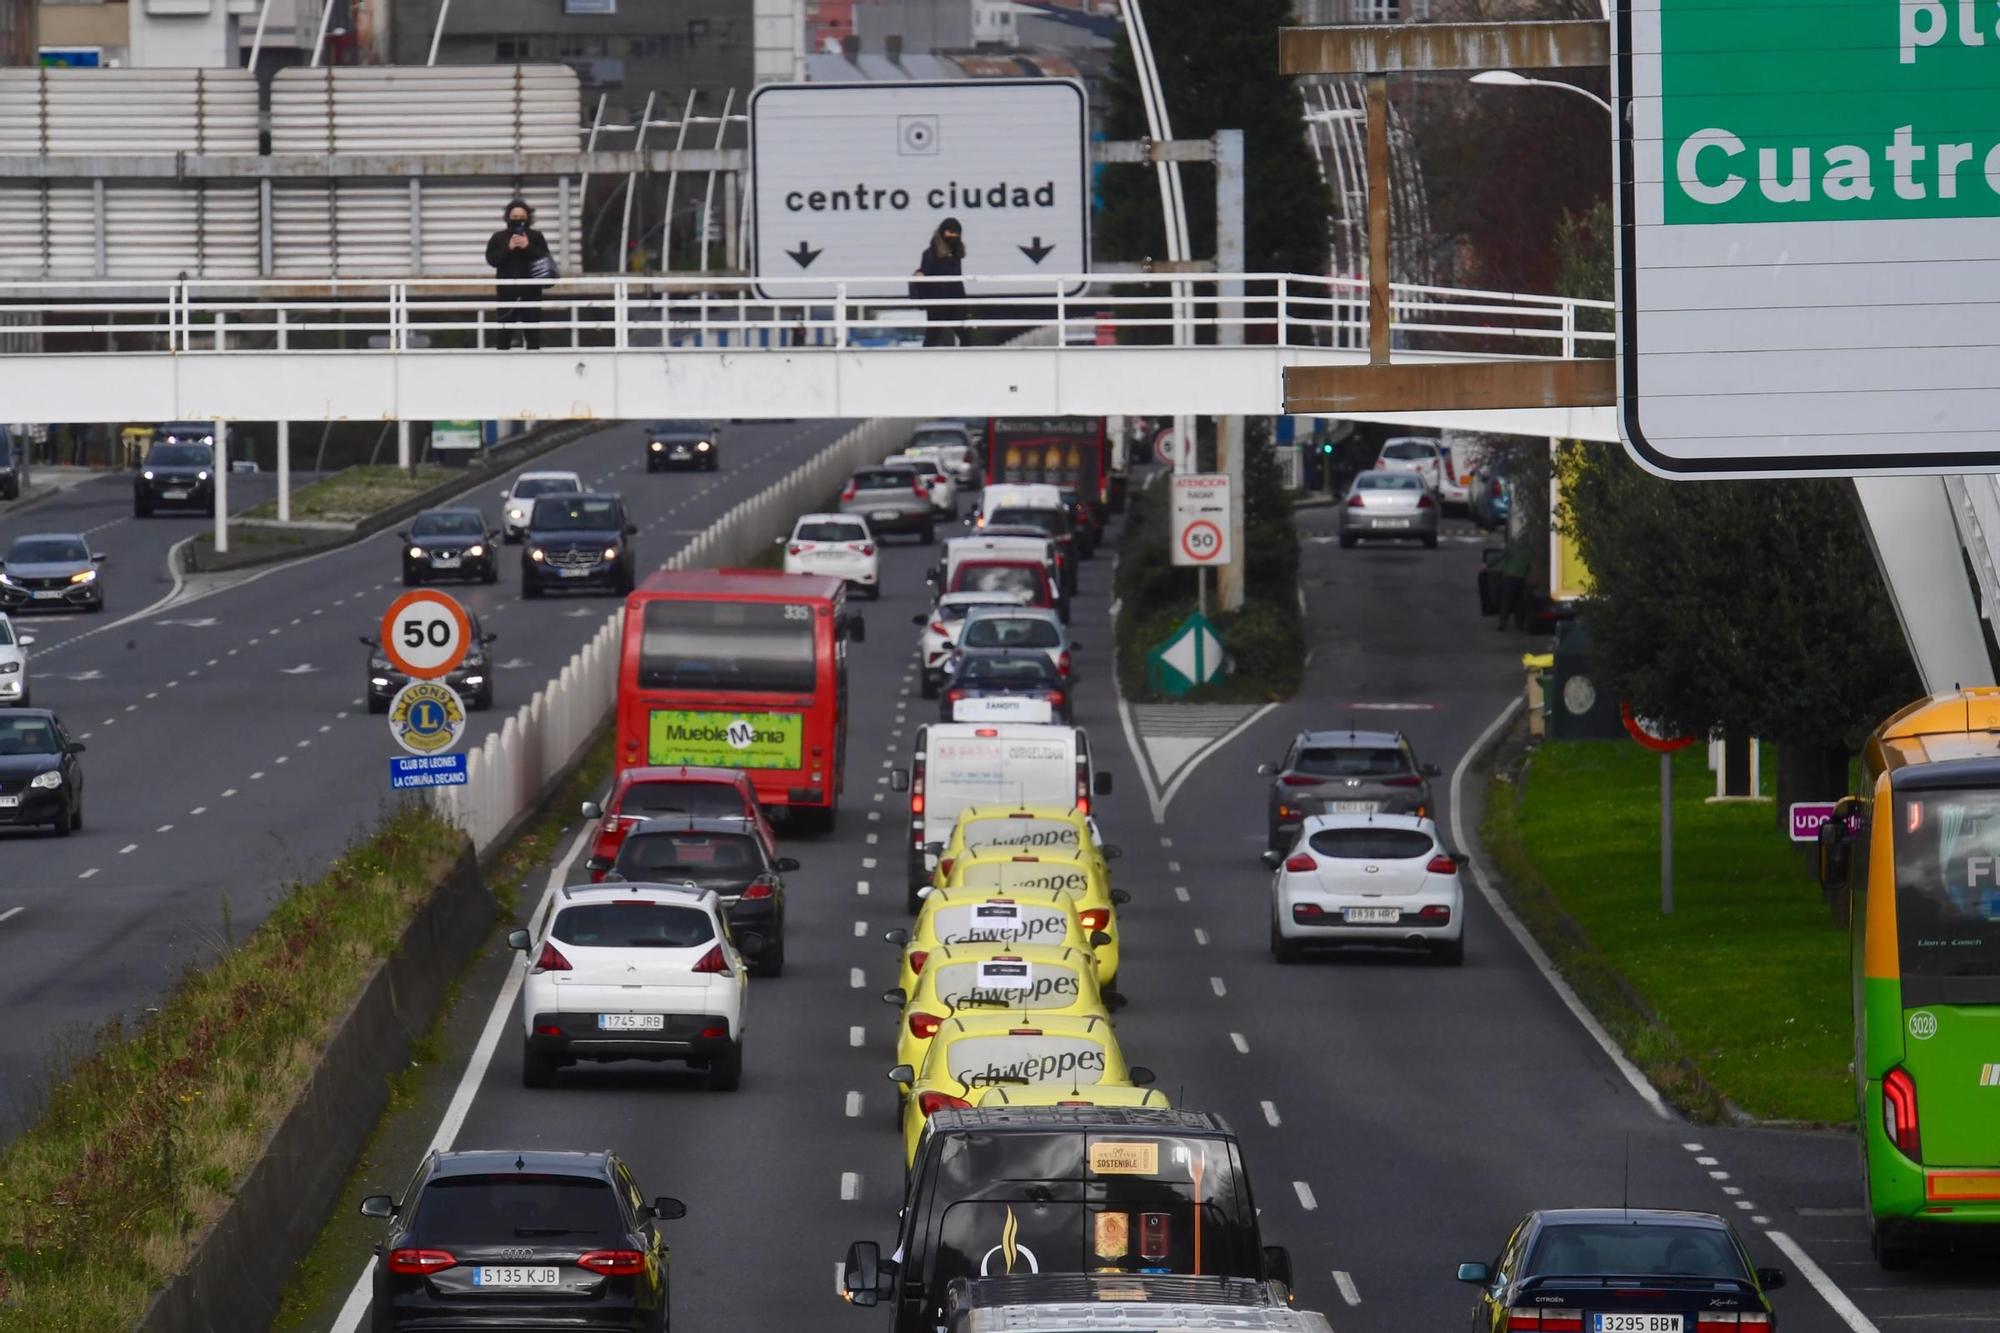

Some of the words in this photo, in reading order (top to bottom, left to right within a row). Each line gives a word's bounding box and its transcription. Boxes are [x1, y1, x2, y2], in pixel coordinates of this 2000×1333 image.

[785, 183, 910, 212] centro
[927, 181, 1054, 209] ciudad
[1192, 534, 1213, 547] 50
[783, 605, 809, 620] 335
[404, 620, 450, 648] 50
[406, 686, 448, 700] LIONS
[419, 704, 438, 728] L
[667, 724, 784, 744] MuebleMania
[400, 759, 418, 770] CLUB
[419, 758, 428, 769] DE
[429, 756, 457, 768] LEONES
[394, 777, 404, 787] LA
[404, 773, 434, 786] CORUÑA
[435, 772, 465, 784] DECANO
[607, 1016, 636, 1027] 1745
[640, 1016, 661, 1027] JRB
[1912, 1017, 1935, 1034] 3028
[958, 1050, 1105, 1099] Schweppes
[1096, 1159, 1137, 1168] SOSTENIBLE
[484, 1269, 522, 1283] 5135
[527, 1269, 556, 1283] KJB
[1605, 1317, 1645, 1331] 3295
[1650, 1317, 1679, 1331] BBW
